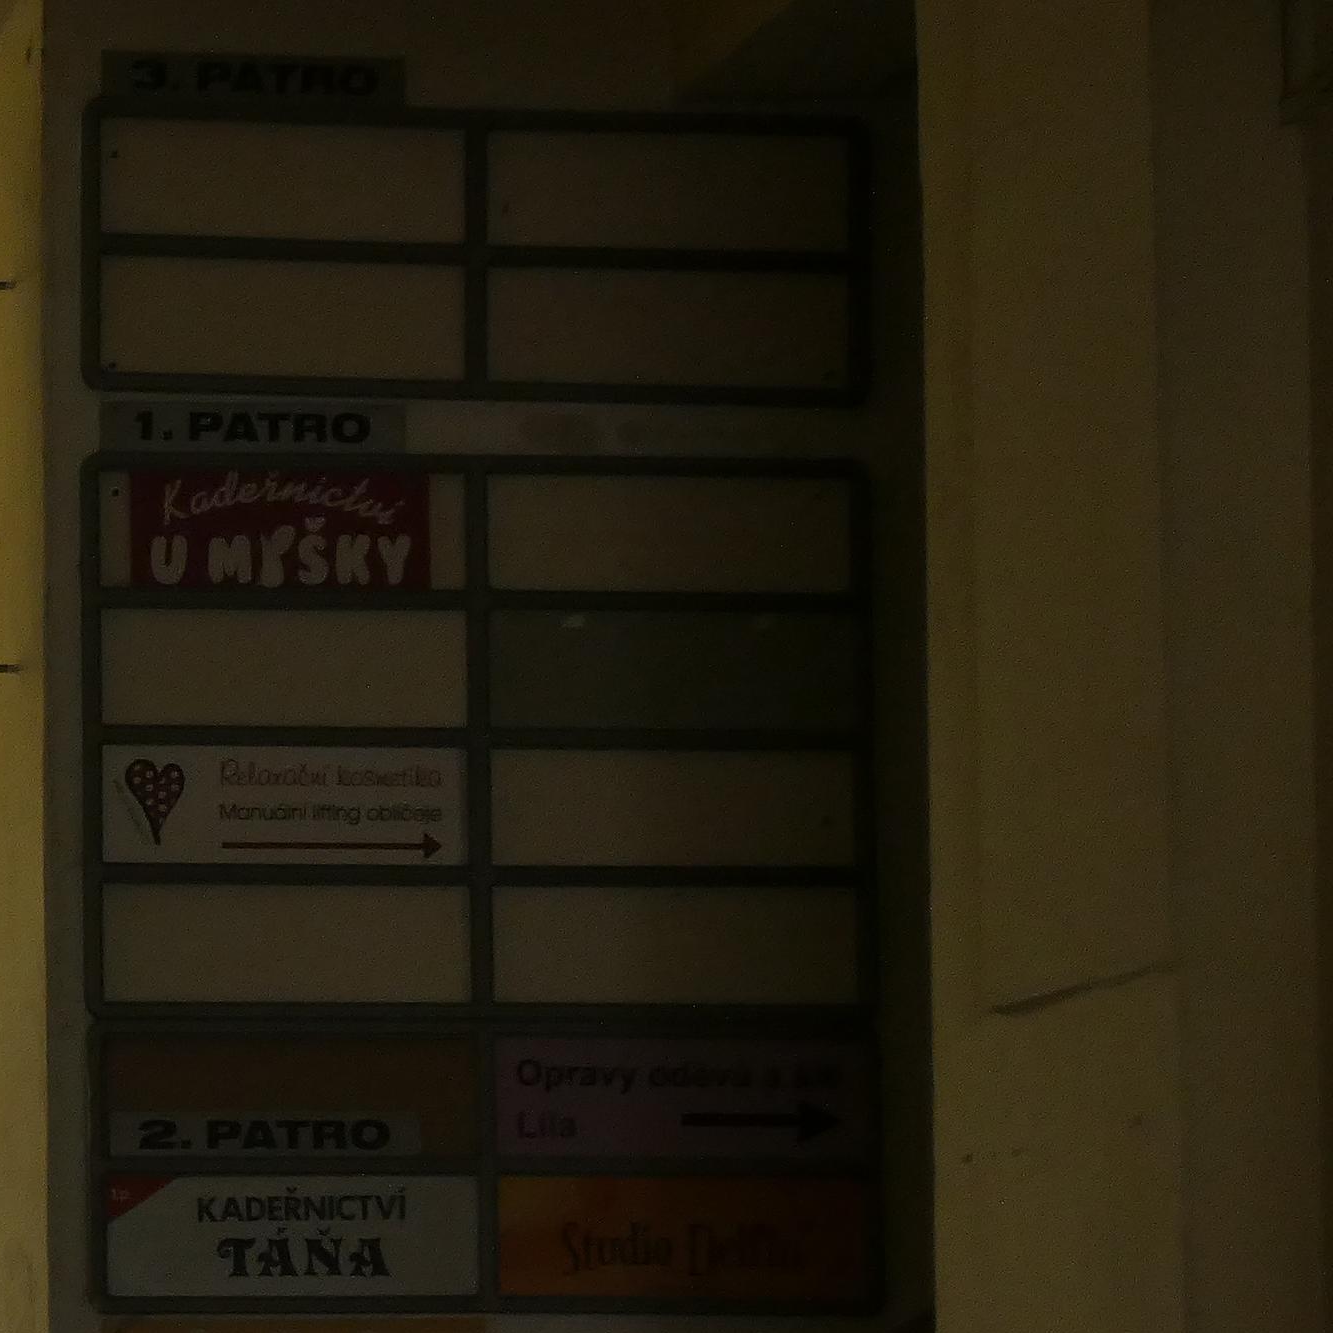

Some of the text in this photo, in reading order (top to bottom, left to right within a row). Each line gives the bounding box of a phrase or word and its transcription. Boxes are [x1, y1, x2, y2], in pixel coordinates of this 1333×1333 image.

[133, 61, 379, 97] 3. PATRO
[136, 411, 371, 443] 1. PATRO
[163, 469, 406, 526] Kadeřnictví
[149, 513, 412, 589] U MYŠKY
[517, 1058, 636, 1094] Opravy
[138, 1118, 391, 1151] 2. PATRO
[197, 1187, 407, 1222] KADEŘNICTVÍ
[216, 1226, 391, 1278] TÁŇA
[560, 1220, 673, 1277] Studio
